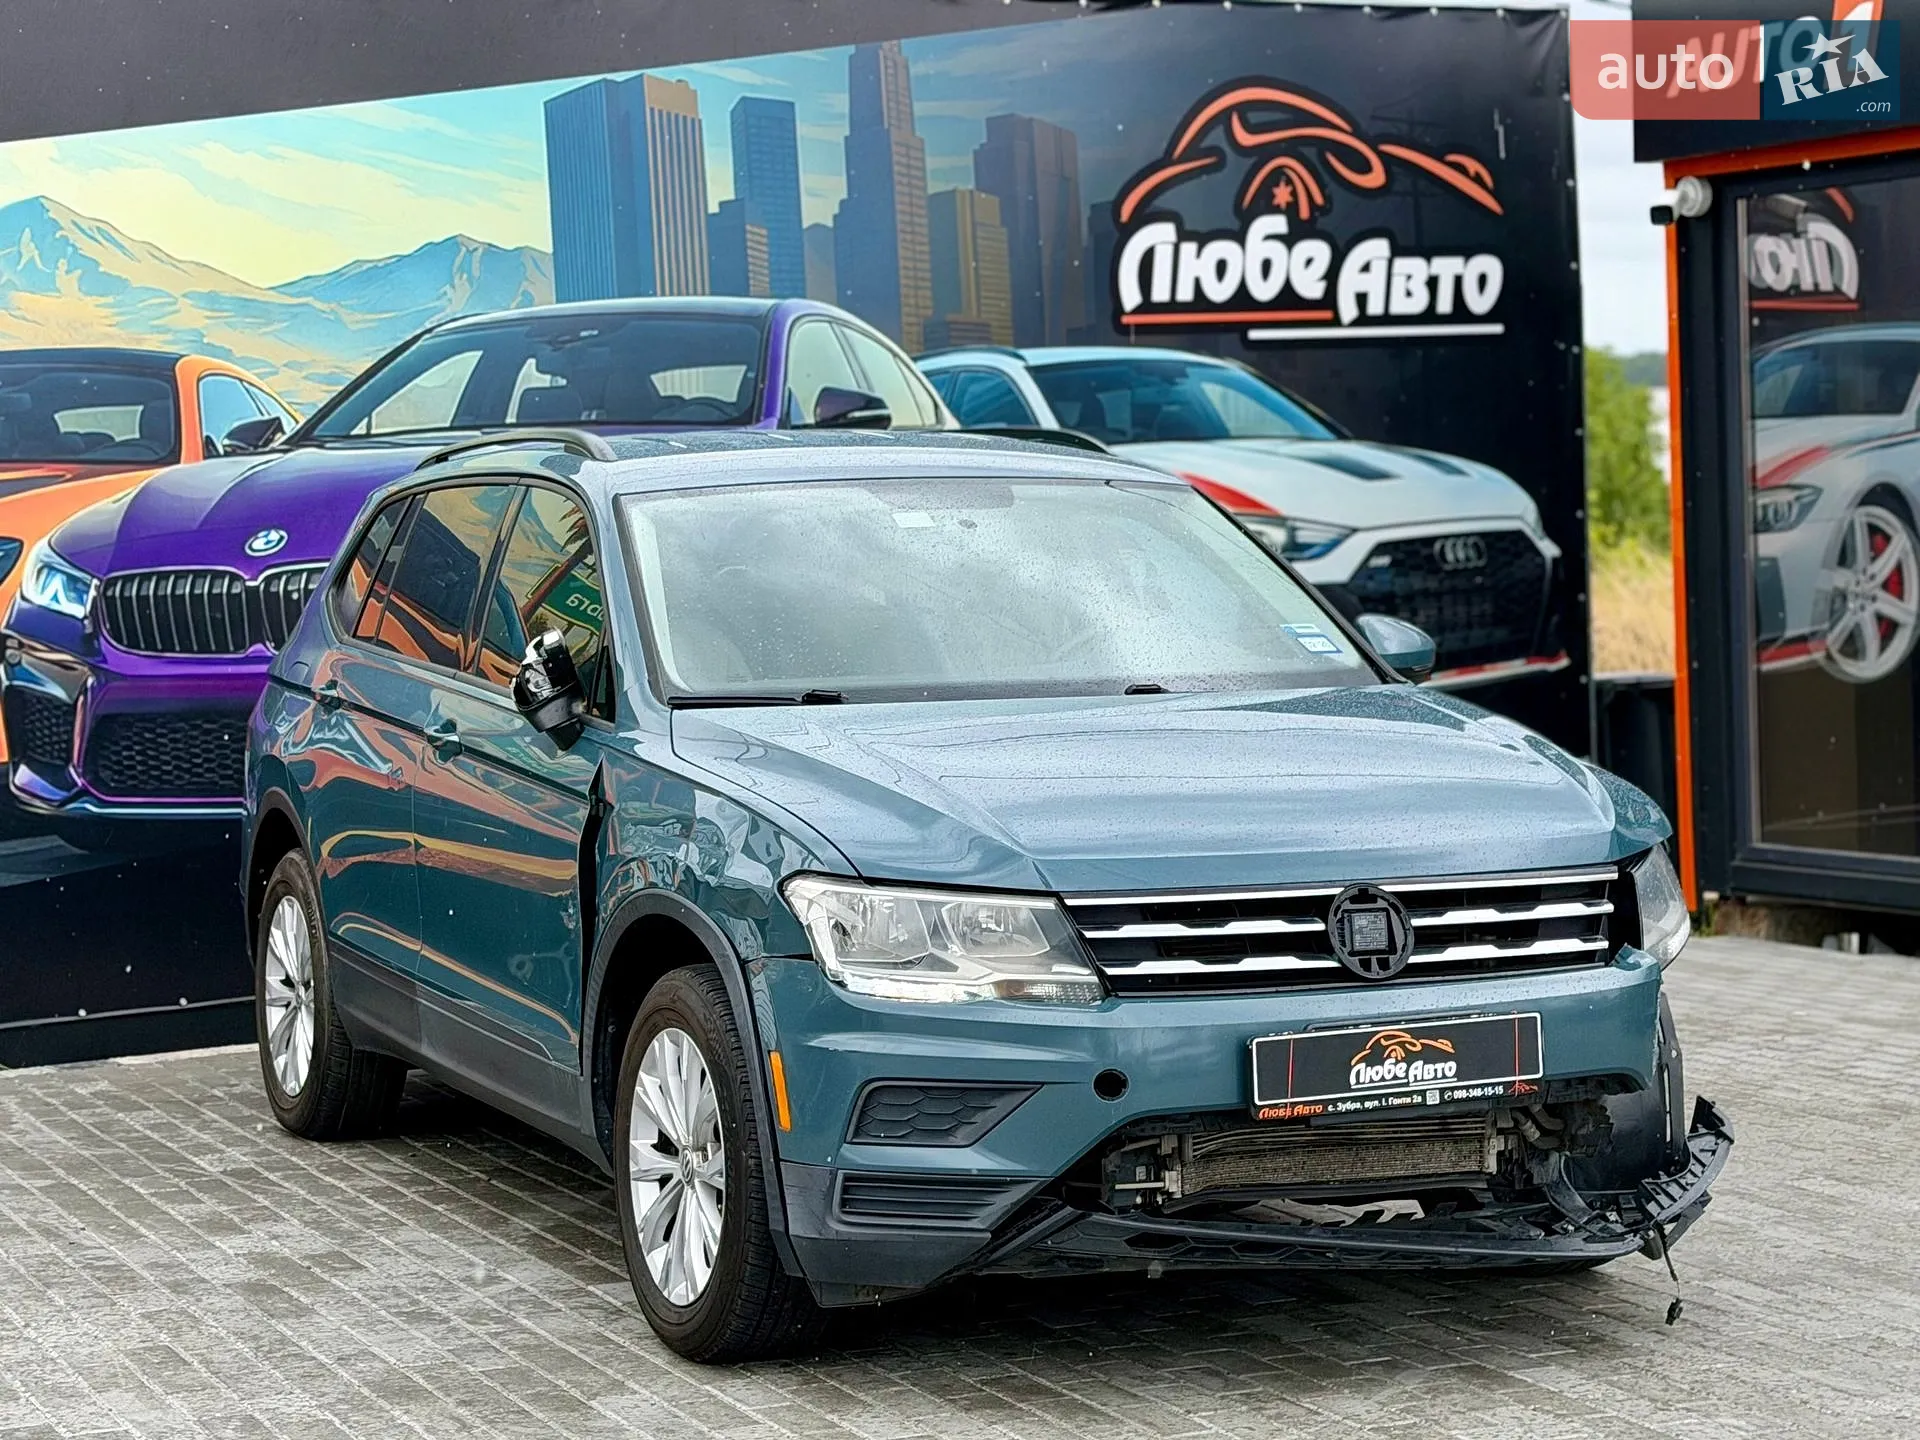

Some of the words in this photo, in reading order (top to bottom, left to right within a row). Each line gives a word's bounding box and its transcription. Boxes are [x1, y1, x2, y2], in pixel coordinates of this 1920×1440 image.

[1118, 213, 1331, 314] Любе
[1337, 238, 1504, 326] Авто
[1350, 1058, 1407, 1086] Любе
[1408, 1060, 1457, 1083] Авто
